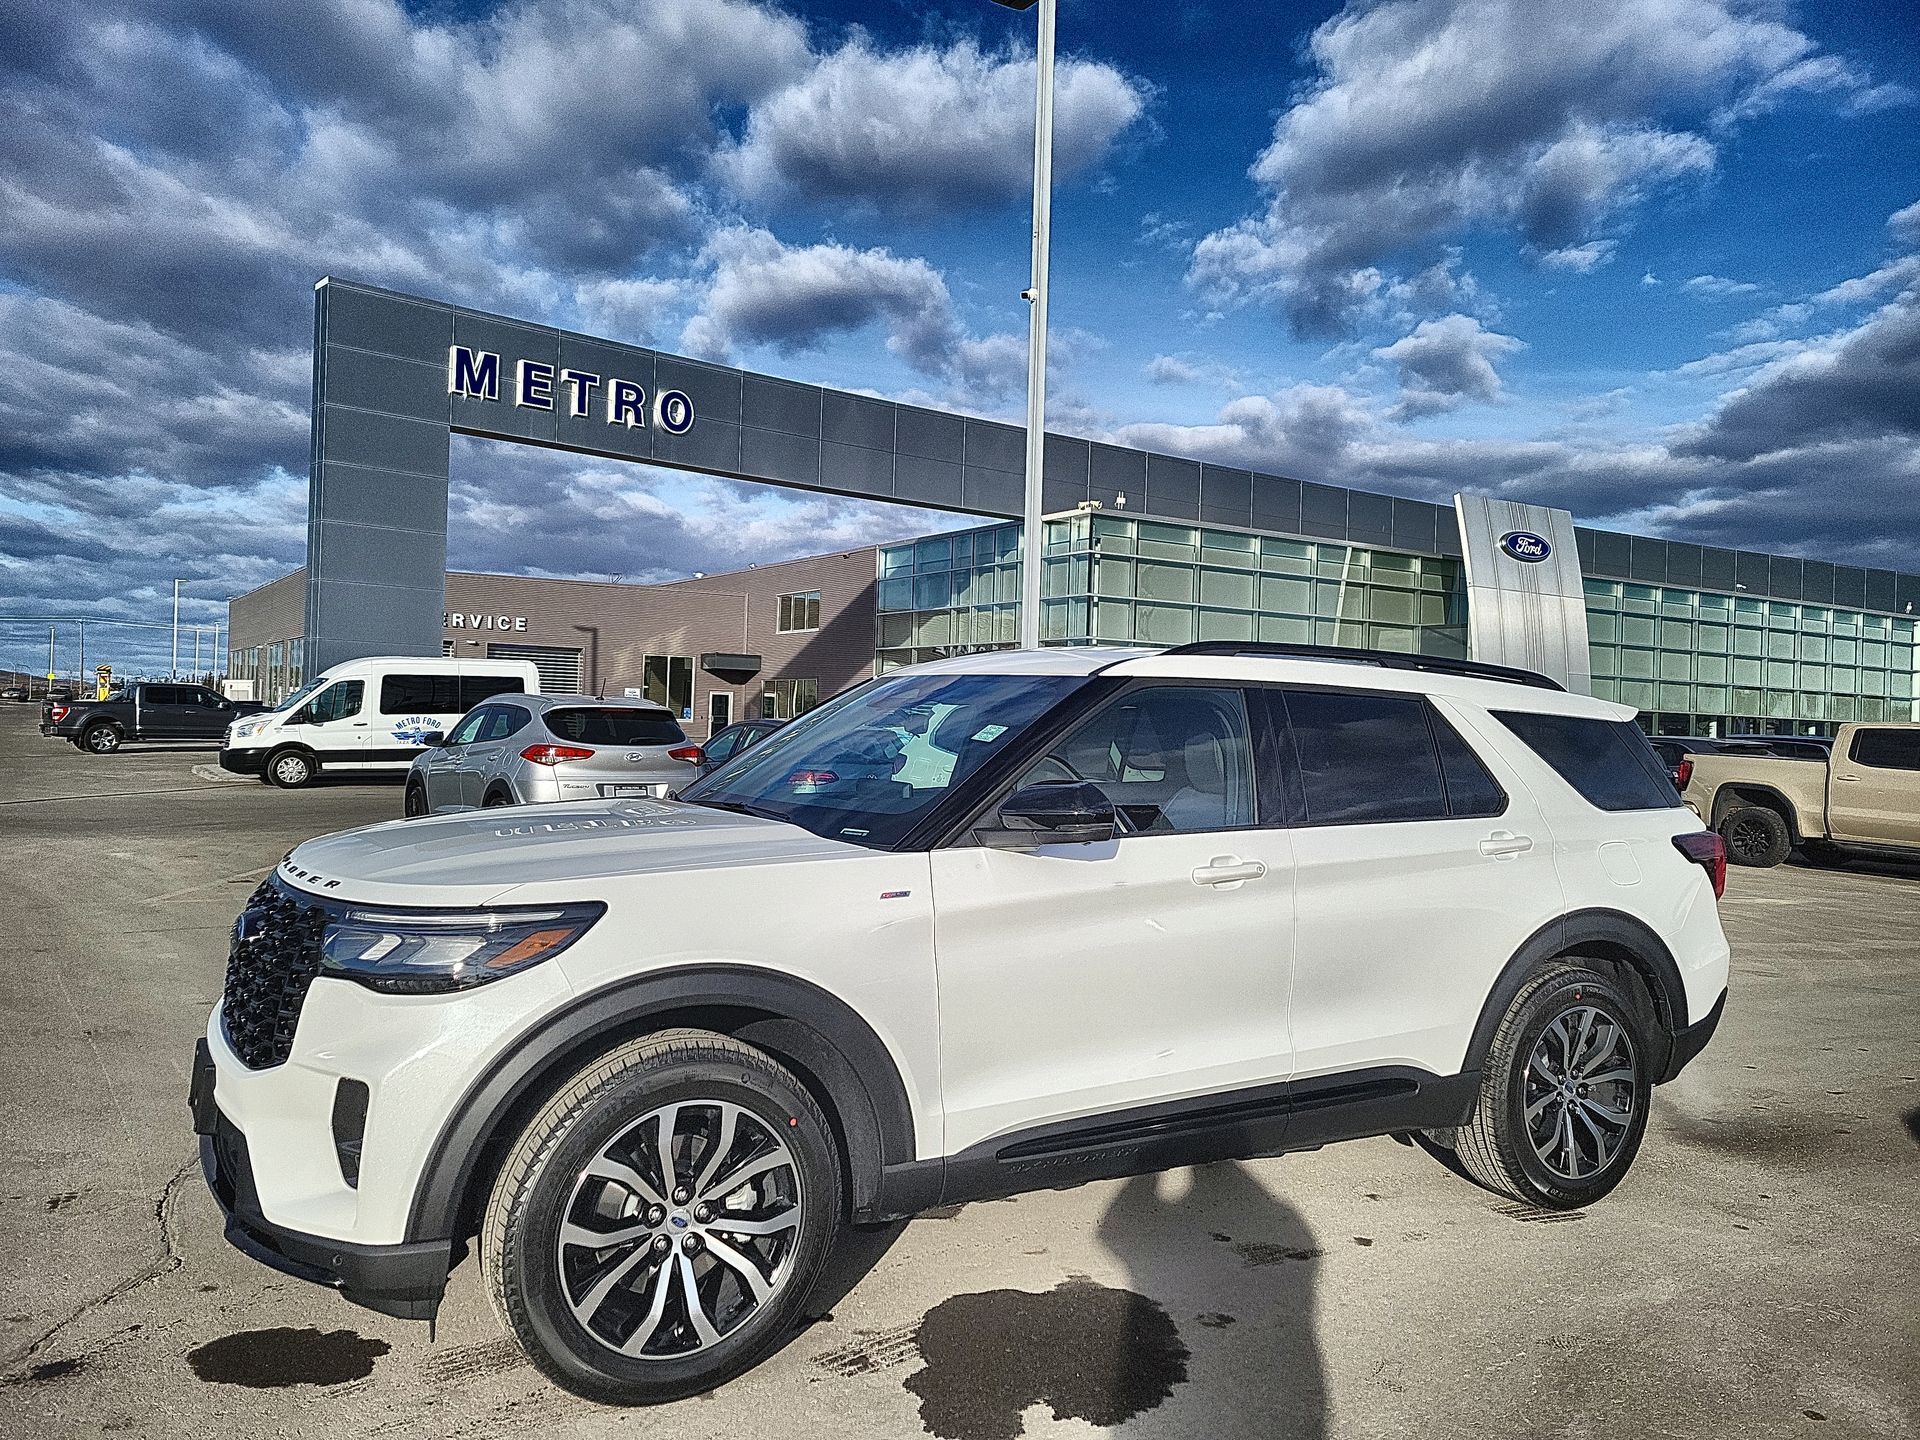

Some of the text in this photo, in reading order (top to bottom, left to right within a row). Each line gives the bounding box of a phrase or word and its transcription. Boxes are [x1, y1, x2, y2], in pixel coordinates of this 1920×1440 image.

[449, 345, 694, 435] METRO
[1516, 537, 1542, 555] Ford
[395, 716, 442, 730] METRO FORD
